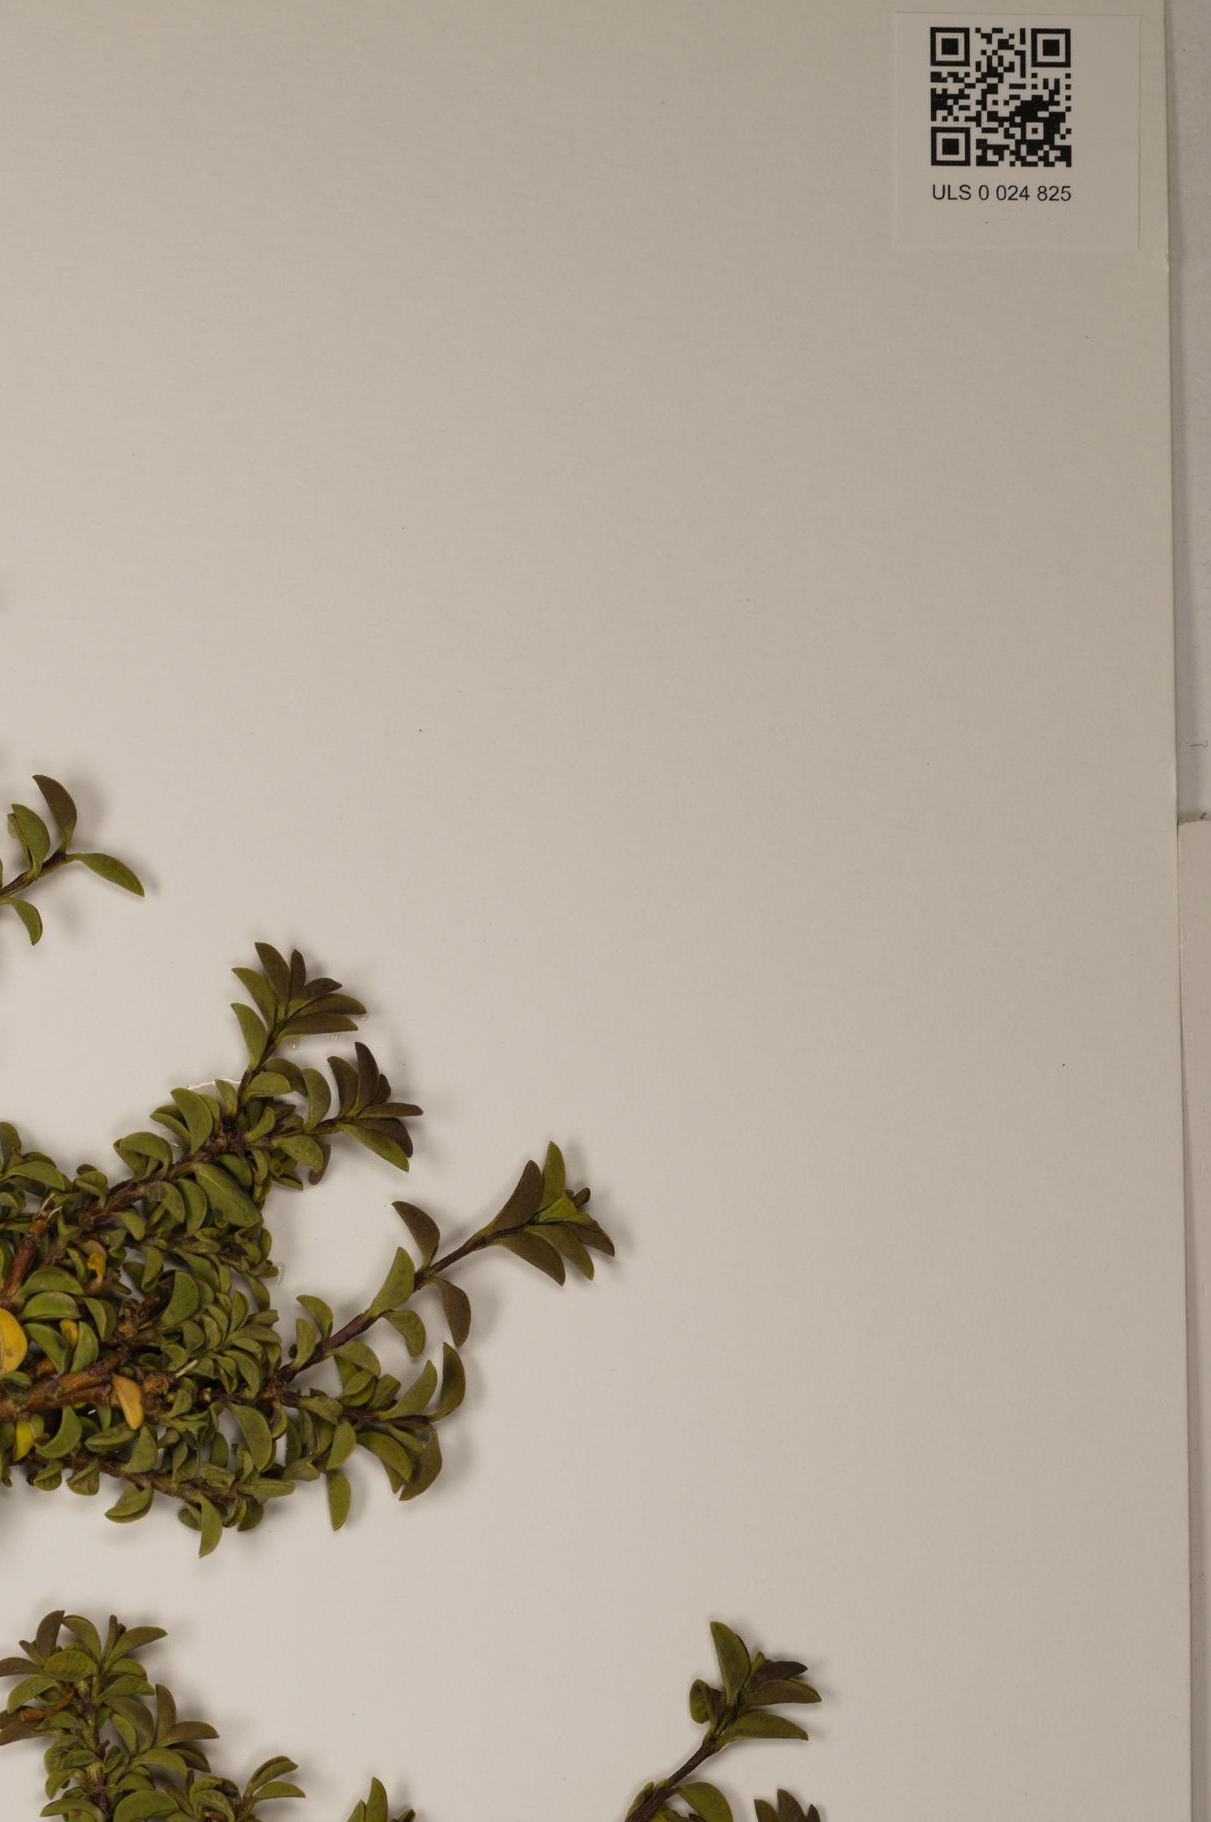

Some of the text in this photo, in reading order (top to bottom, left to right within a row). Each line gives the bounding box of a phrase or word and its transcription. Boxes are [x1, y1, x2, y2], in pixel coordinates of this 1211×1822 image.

[932, 184, 1072, 202] ULS 0 024 825
